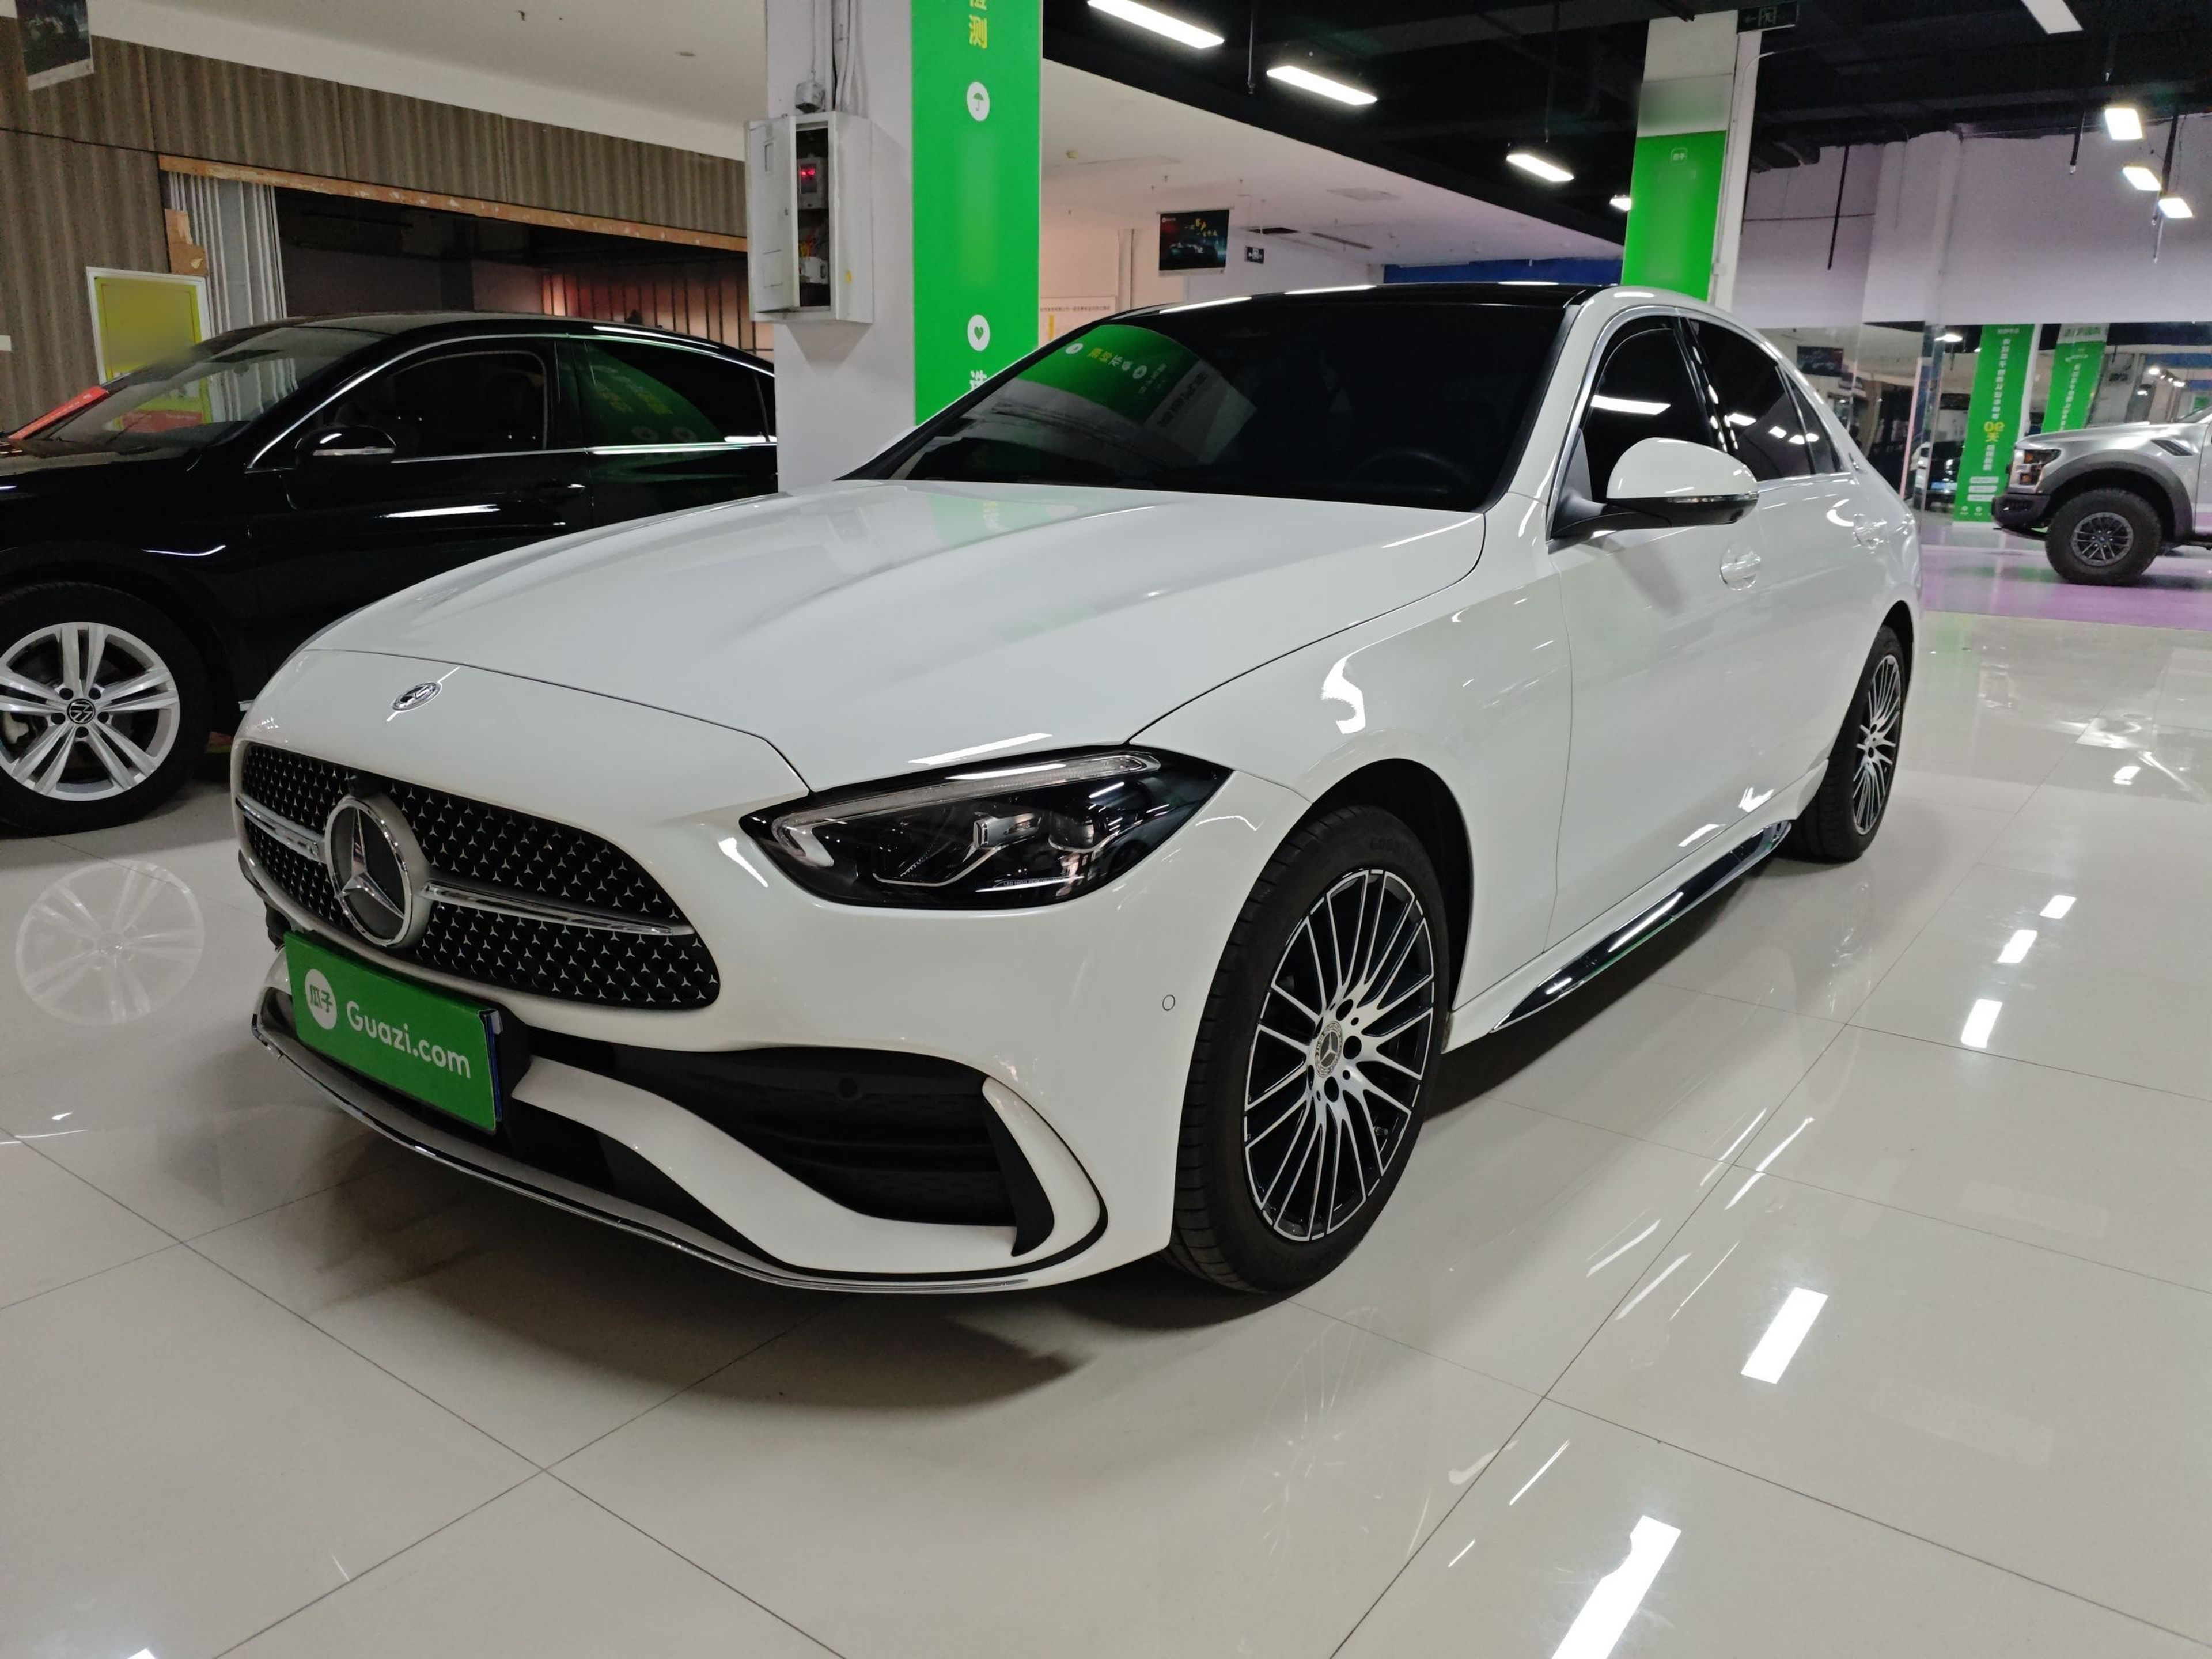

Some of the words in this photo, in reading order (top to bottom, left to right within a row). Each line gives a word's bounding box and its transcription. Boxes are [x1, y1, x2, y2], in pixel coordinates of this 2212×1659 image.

[969, 0, 988, 49] 测
[309, 984, 333, 1013] 瓜子
[346, 1000, 471, 1079] Guazi.com
